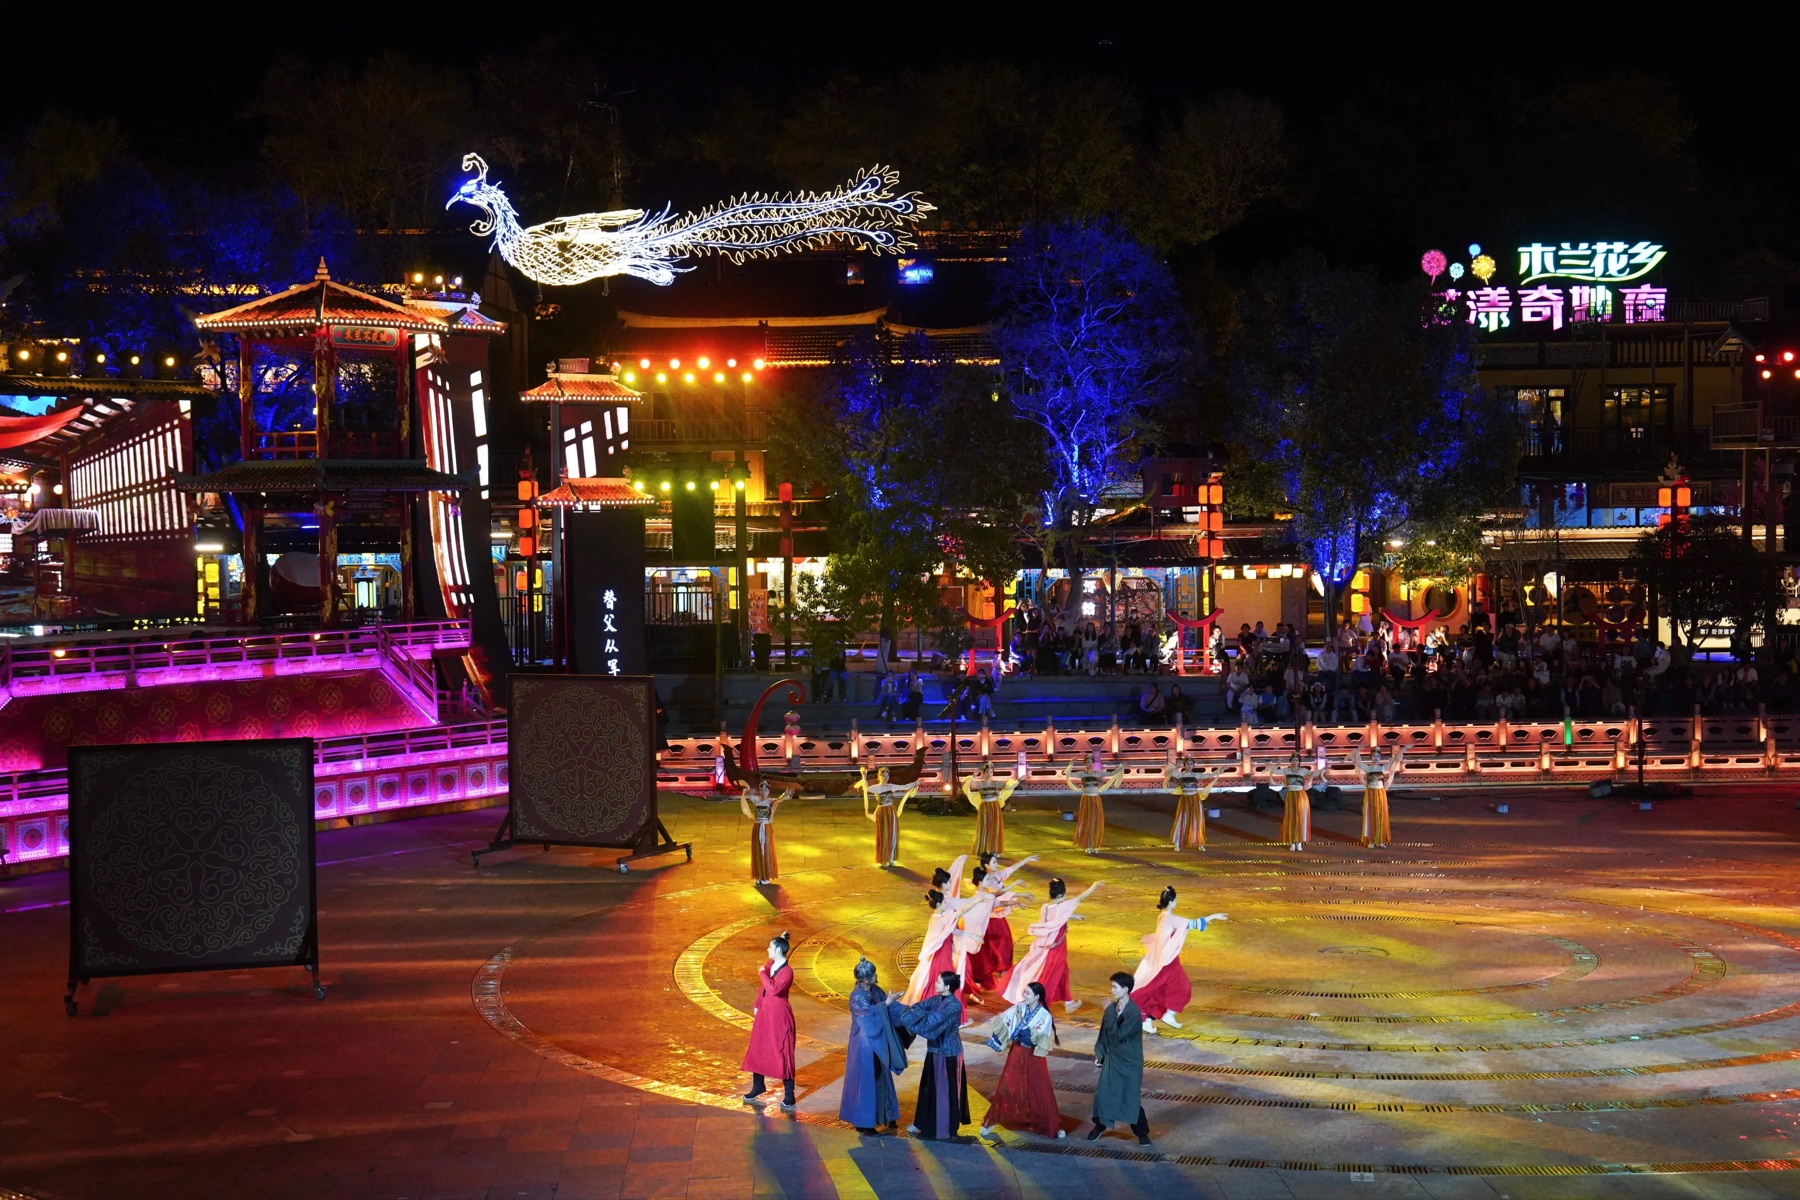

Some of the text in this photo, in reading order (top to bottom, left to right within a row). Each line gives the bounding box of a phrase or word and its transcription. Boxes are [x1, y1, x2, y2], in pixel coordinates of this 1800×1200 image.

[1518, 241, 1667, 284] 木兰花乡
[603, 589, 621, 677] 替父从军
